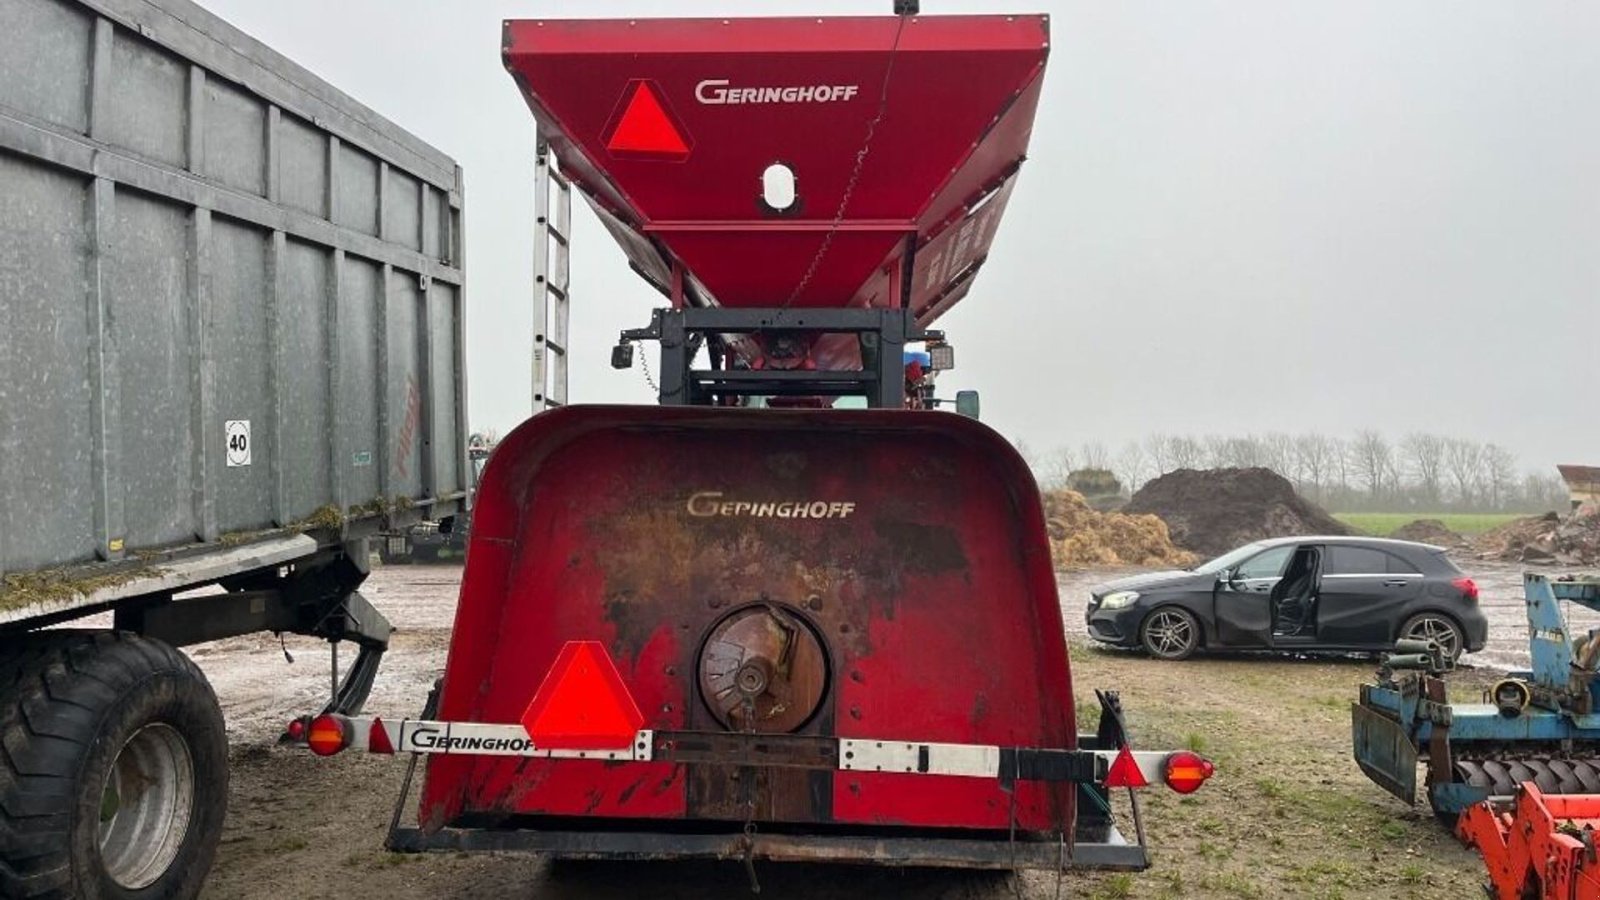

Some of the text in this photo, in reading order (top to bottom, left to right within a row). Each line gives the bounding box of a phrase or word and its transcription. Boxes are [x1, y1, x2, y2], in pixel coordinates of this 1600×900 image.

[695, 79, 858, 104] GERINGHOFF
[230, 434, 247, 452] 40
[411, 728, 538, 751] GERINGHOF
